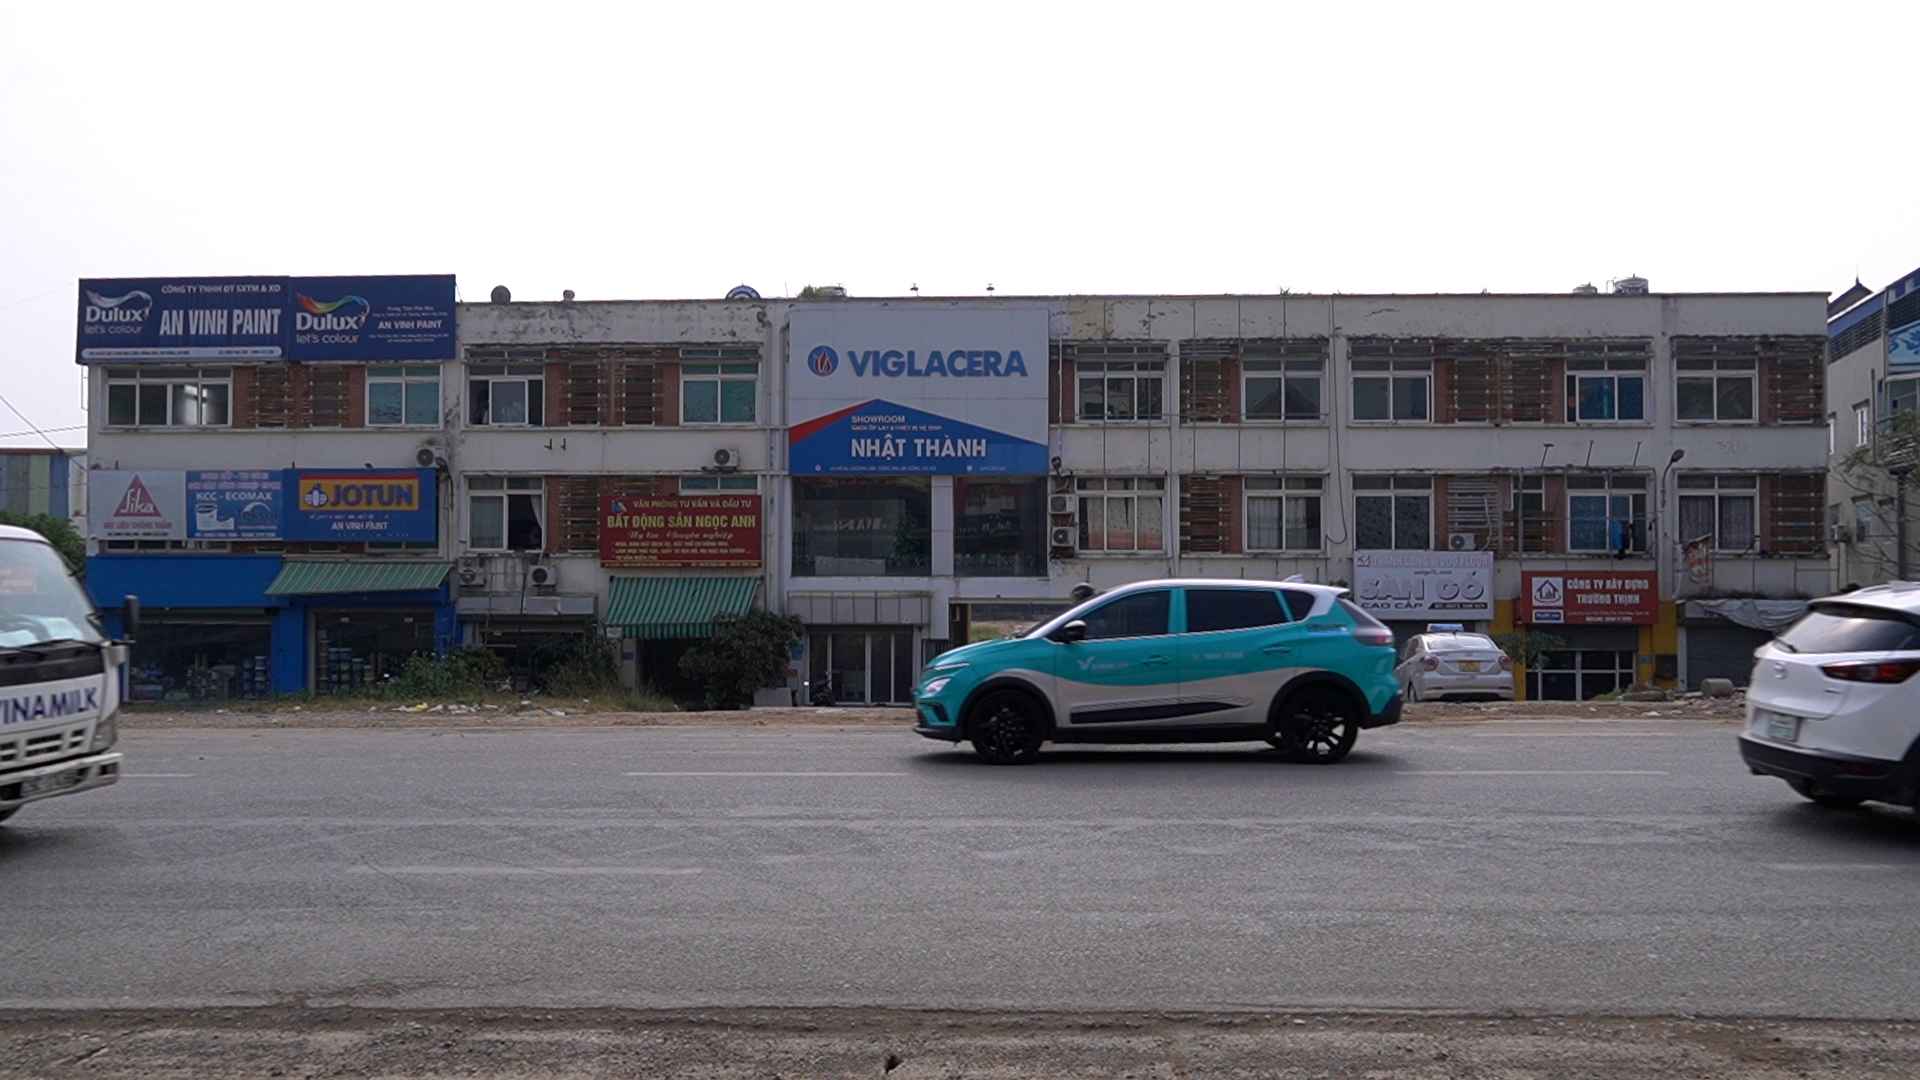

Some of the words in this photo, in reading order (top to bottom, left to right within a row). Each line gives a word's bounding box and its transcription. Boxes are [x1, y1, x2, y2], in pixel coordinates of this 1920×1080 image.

[187, 285, 198, 294] TY
[85, 305, 143, 323] Dulux
[159, 309, 184, 336] AN
[188, 309, 228, 336] VINH
[232, 308, 282, 336] PAINT
[295, 312, 359, 331] Dulux
[377, 320, 393, 330] AN
[394, 320, 415, 330] VINH
[416, 319, 442, 329] PAINT
[84, 324, 106, 335] let's
[107, 325, 142, 335] colour
[295, 333, 320, 345] let's
[321, 333, 359, 345] colour
[848, 349, 1029, 378] VIGLACERA
[851, 415, 906, 424] SHOWROOM
[851, 433, 906, 461] NHẬT
[913, 434, 987, 458] THÀNH
[225, 491, 273, 501] ECOMAX
[330, 484, 414, 507] JOTUN
[331, 522, 346, 531] AN
[607, 511, 629, 529] BẤT
[632, 513, 665, 530] ĐỘNG
[667, 511, 693, 529] SẢN
[695, 515, 729, 531] NGỌC
[730, 515, 756, 529] ANH
[1592, 579, 1604, 590] TY
[1394, 600, 1423, 609] CẤP
